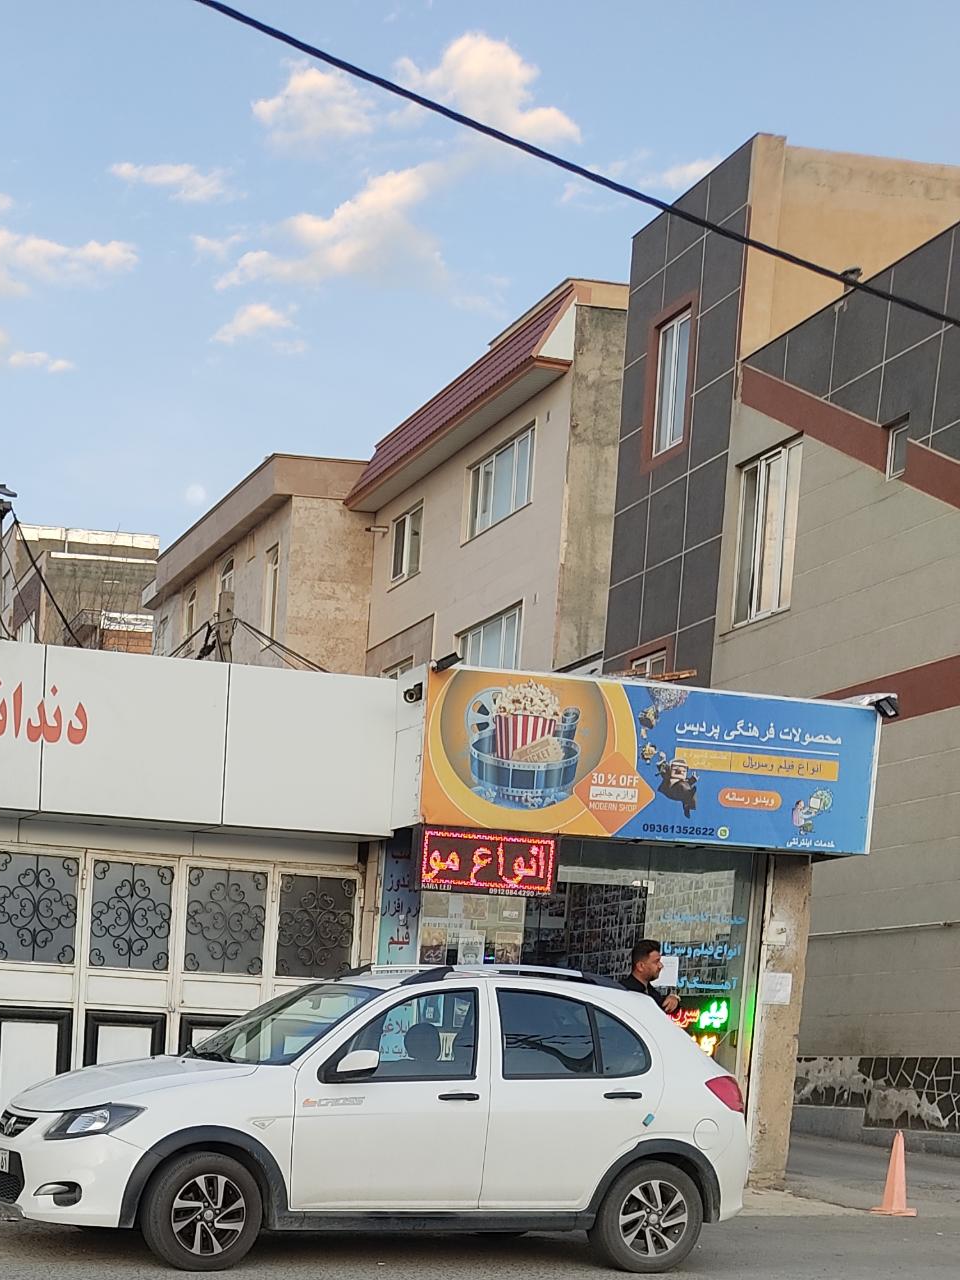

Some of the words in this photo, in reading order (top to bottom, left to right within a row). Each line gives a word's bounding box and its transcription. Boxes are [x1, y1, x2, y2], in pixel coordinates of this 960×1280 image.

[675, 721, 720, 740] پردیس
[724, 720, 775, 742] فرهنگی
[779, 726, 842, 745] محصولات
[797, 762, 822, 776] انواع
[591, 773, 605, 785] 30
[619, 775, 639, 787] OFF
[589, 802, 618, 811] MODERN
[642, 823, 715, 837] 09361352622
[470, 841, 545, 885] انواع
[693, 942, 714, 958] فیلم
[714, 943, 742, 961] انواع
[699, 1000, 729, 1029] فیلم
